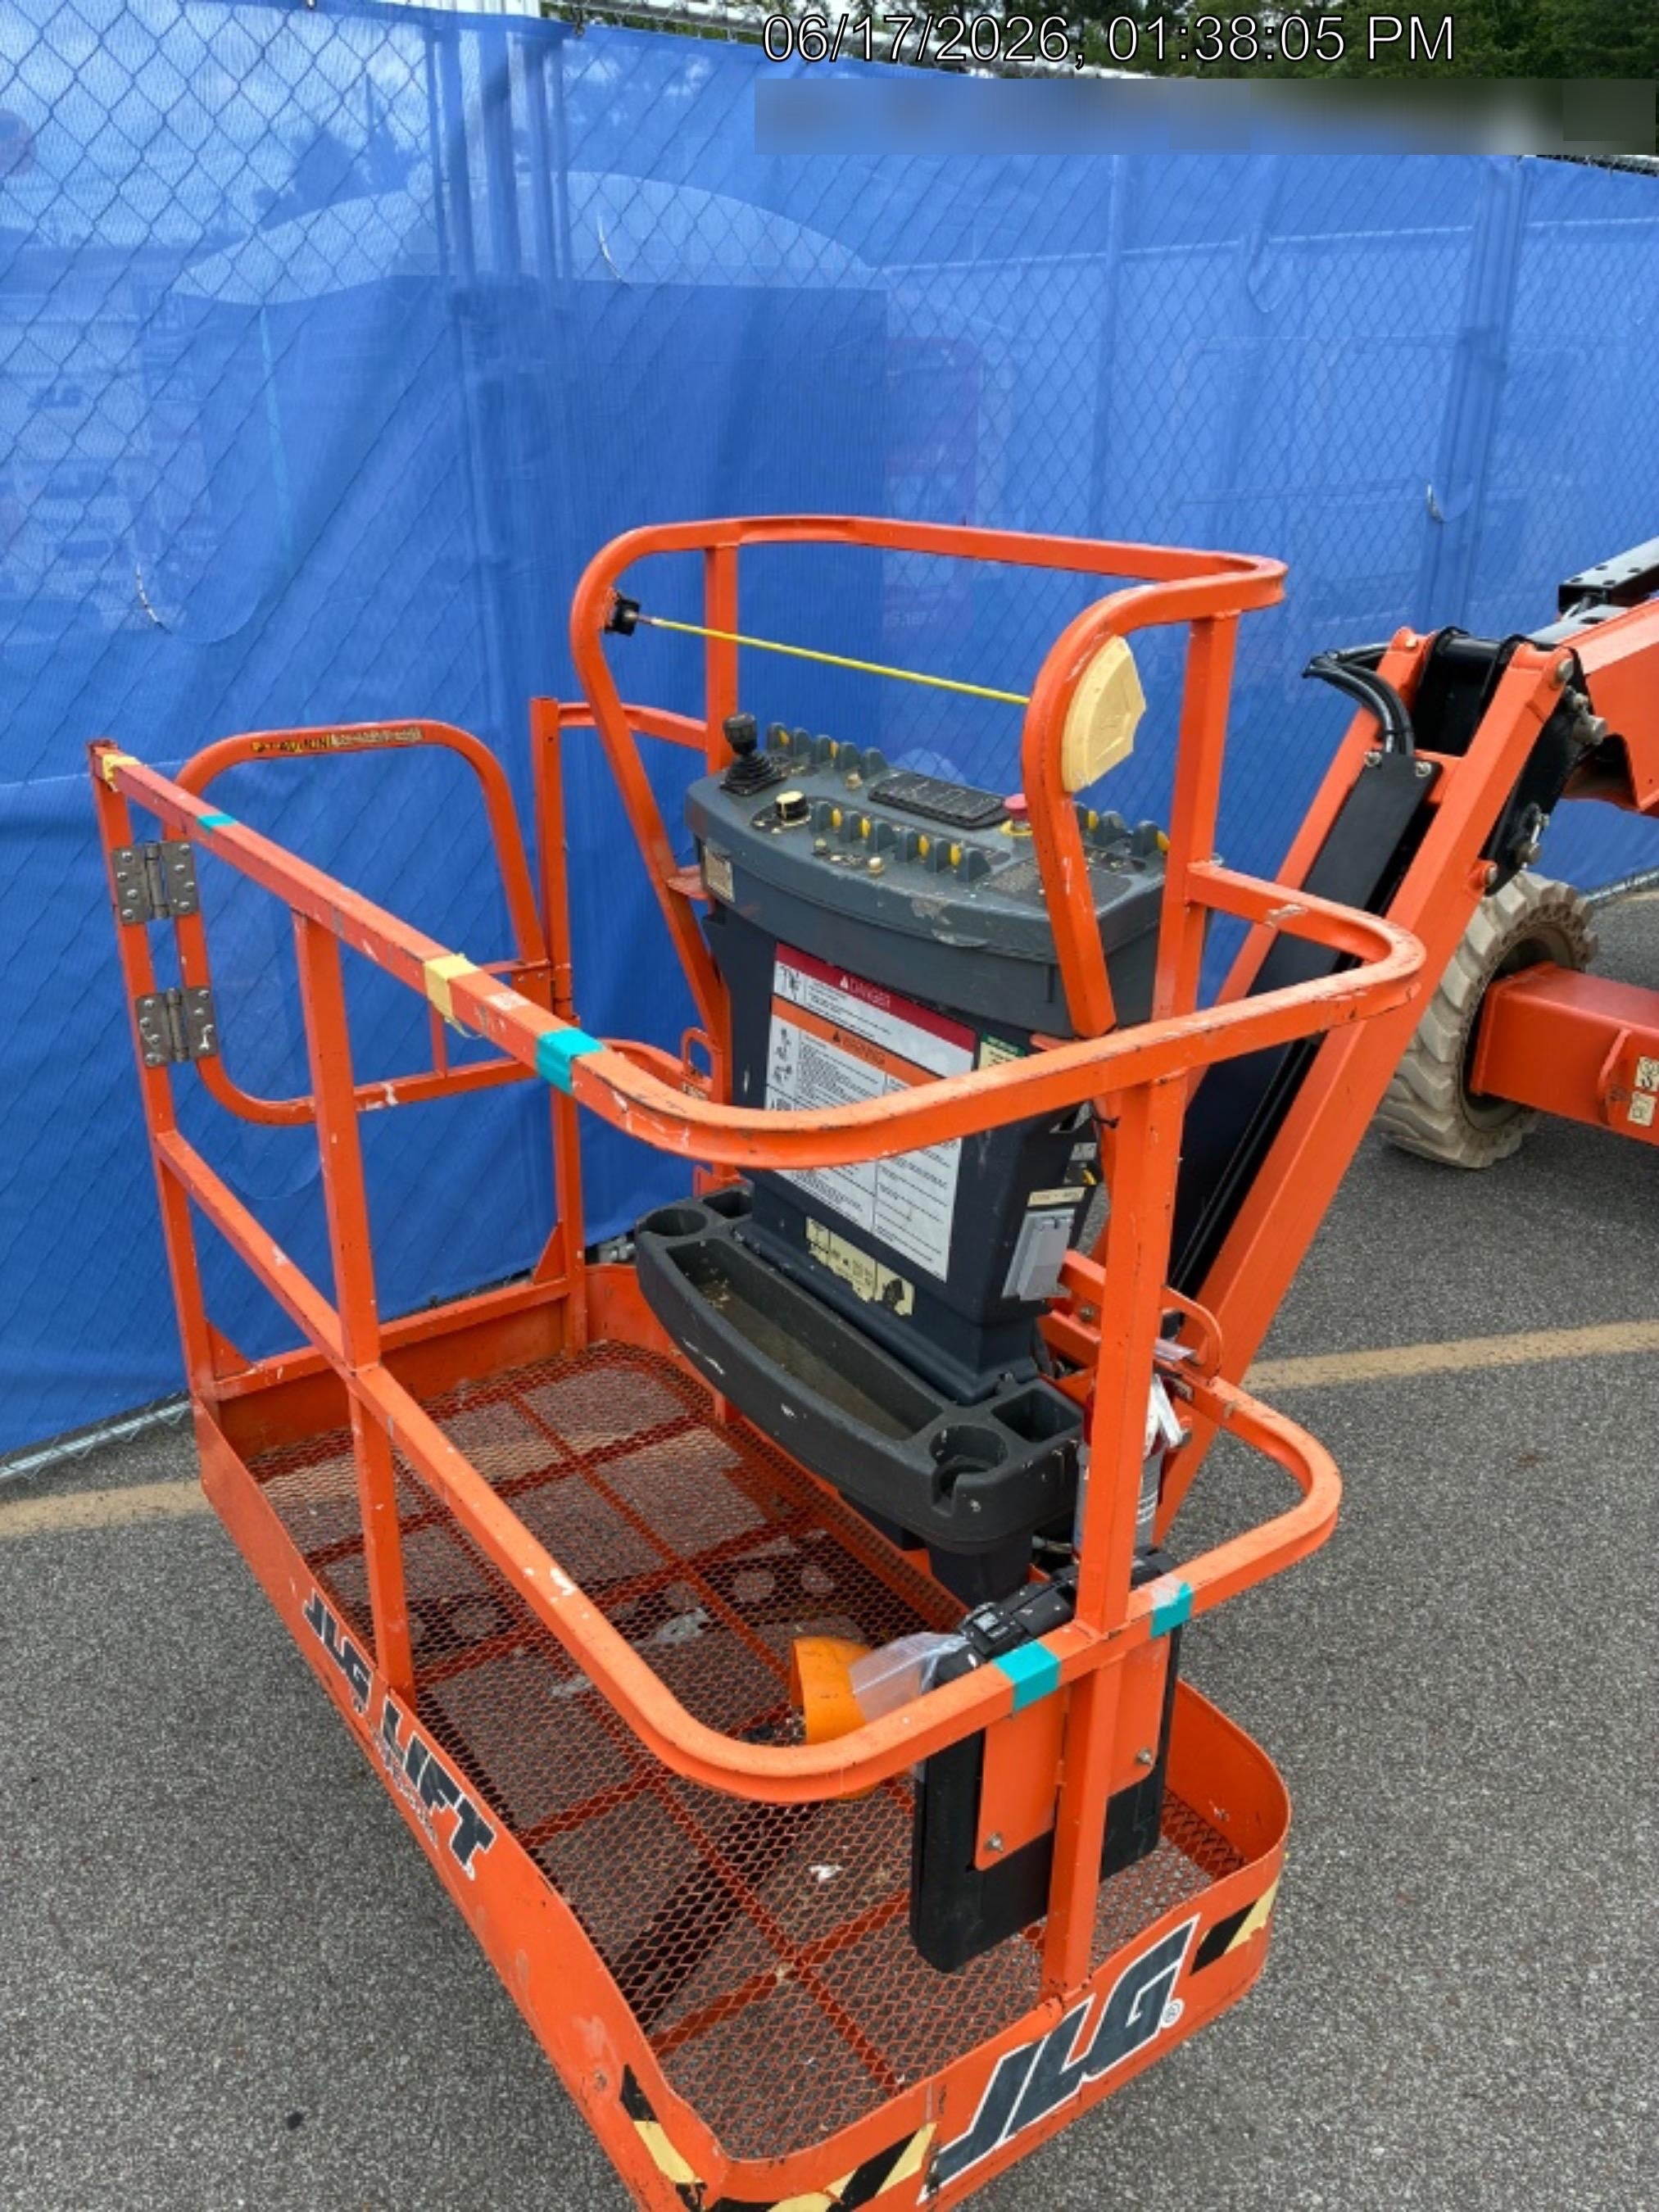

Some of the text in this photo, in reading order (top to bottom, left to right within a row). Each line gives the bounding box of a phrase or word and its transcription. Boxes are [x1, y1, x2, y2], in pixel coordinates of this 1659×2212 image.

[850, 977, 891, 1009] DANGER
[379, 1693, 496, 1882] LIFT
[917, 1911, 1202, 2206] JLG
